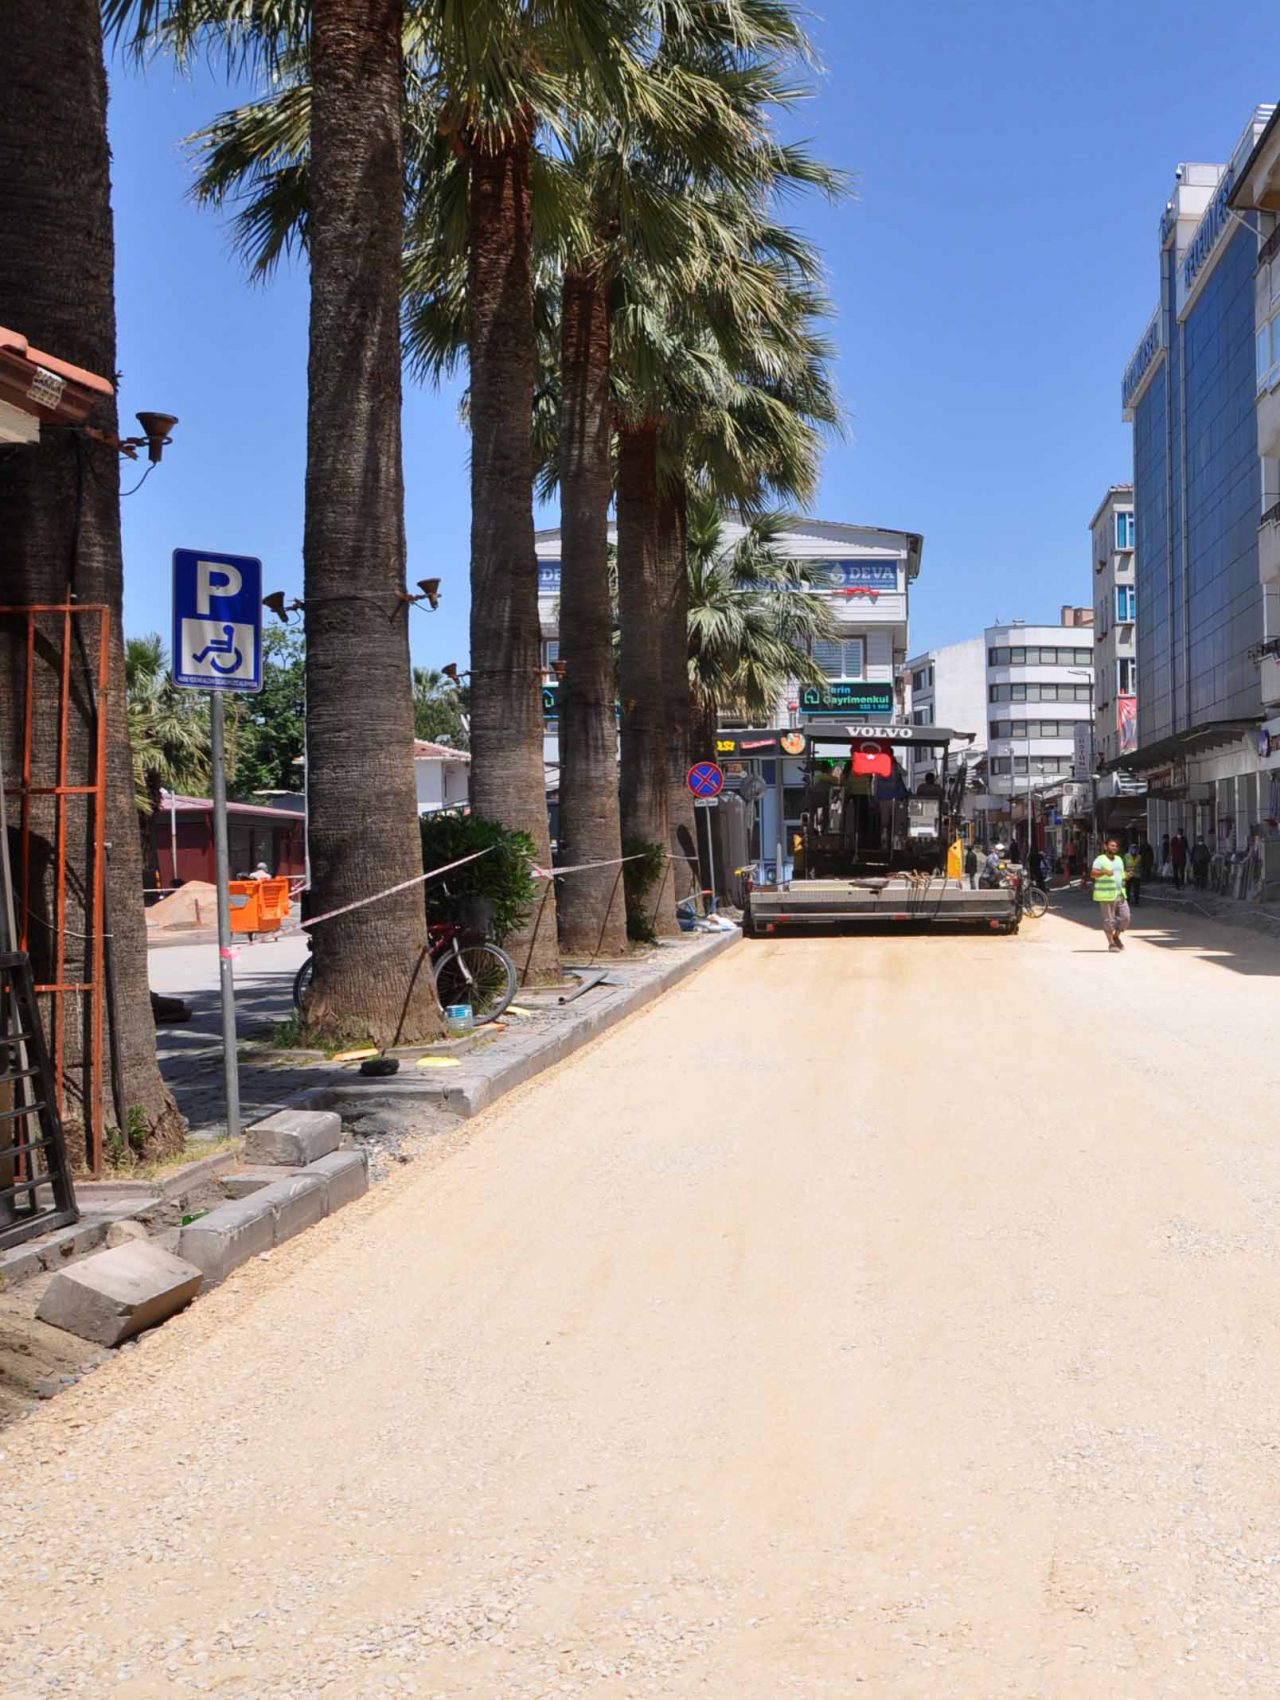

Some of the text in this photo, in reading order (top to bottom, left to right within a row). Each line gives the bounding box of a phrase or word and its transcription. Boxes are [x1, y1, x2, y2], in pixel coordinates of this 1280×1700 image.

[542, 568, 561, 581] DE
[849, 567, 895, 580] DEVA
[196, 560, 243, 616] P
[846, 726, 913, 738] VOLVO
